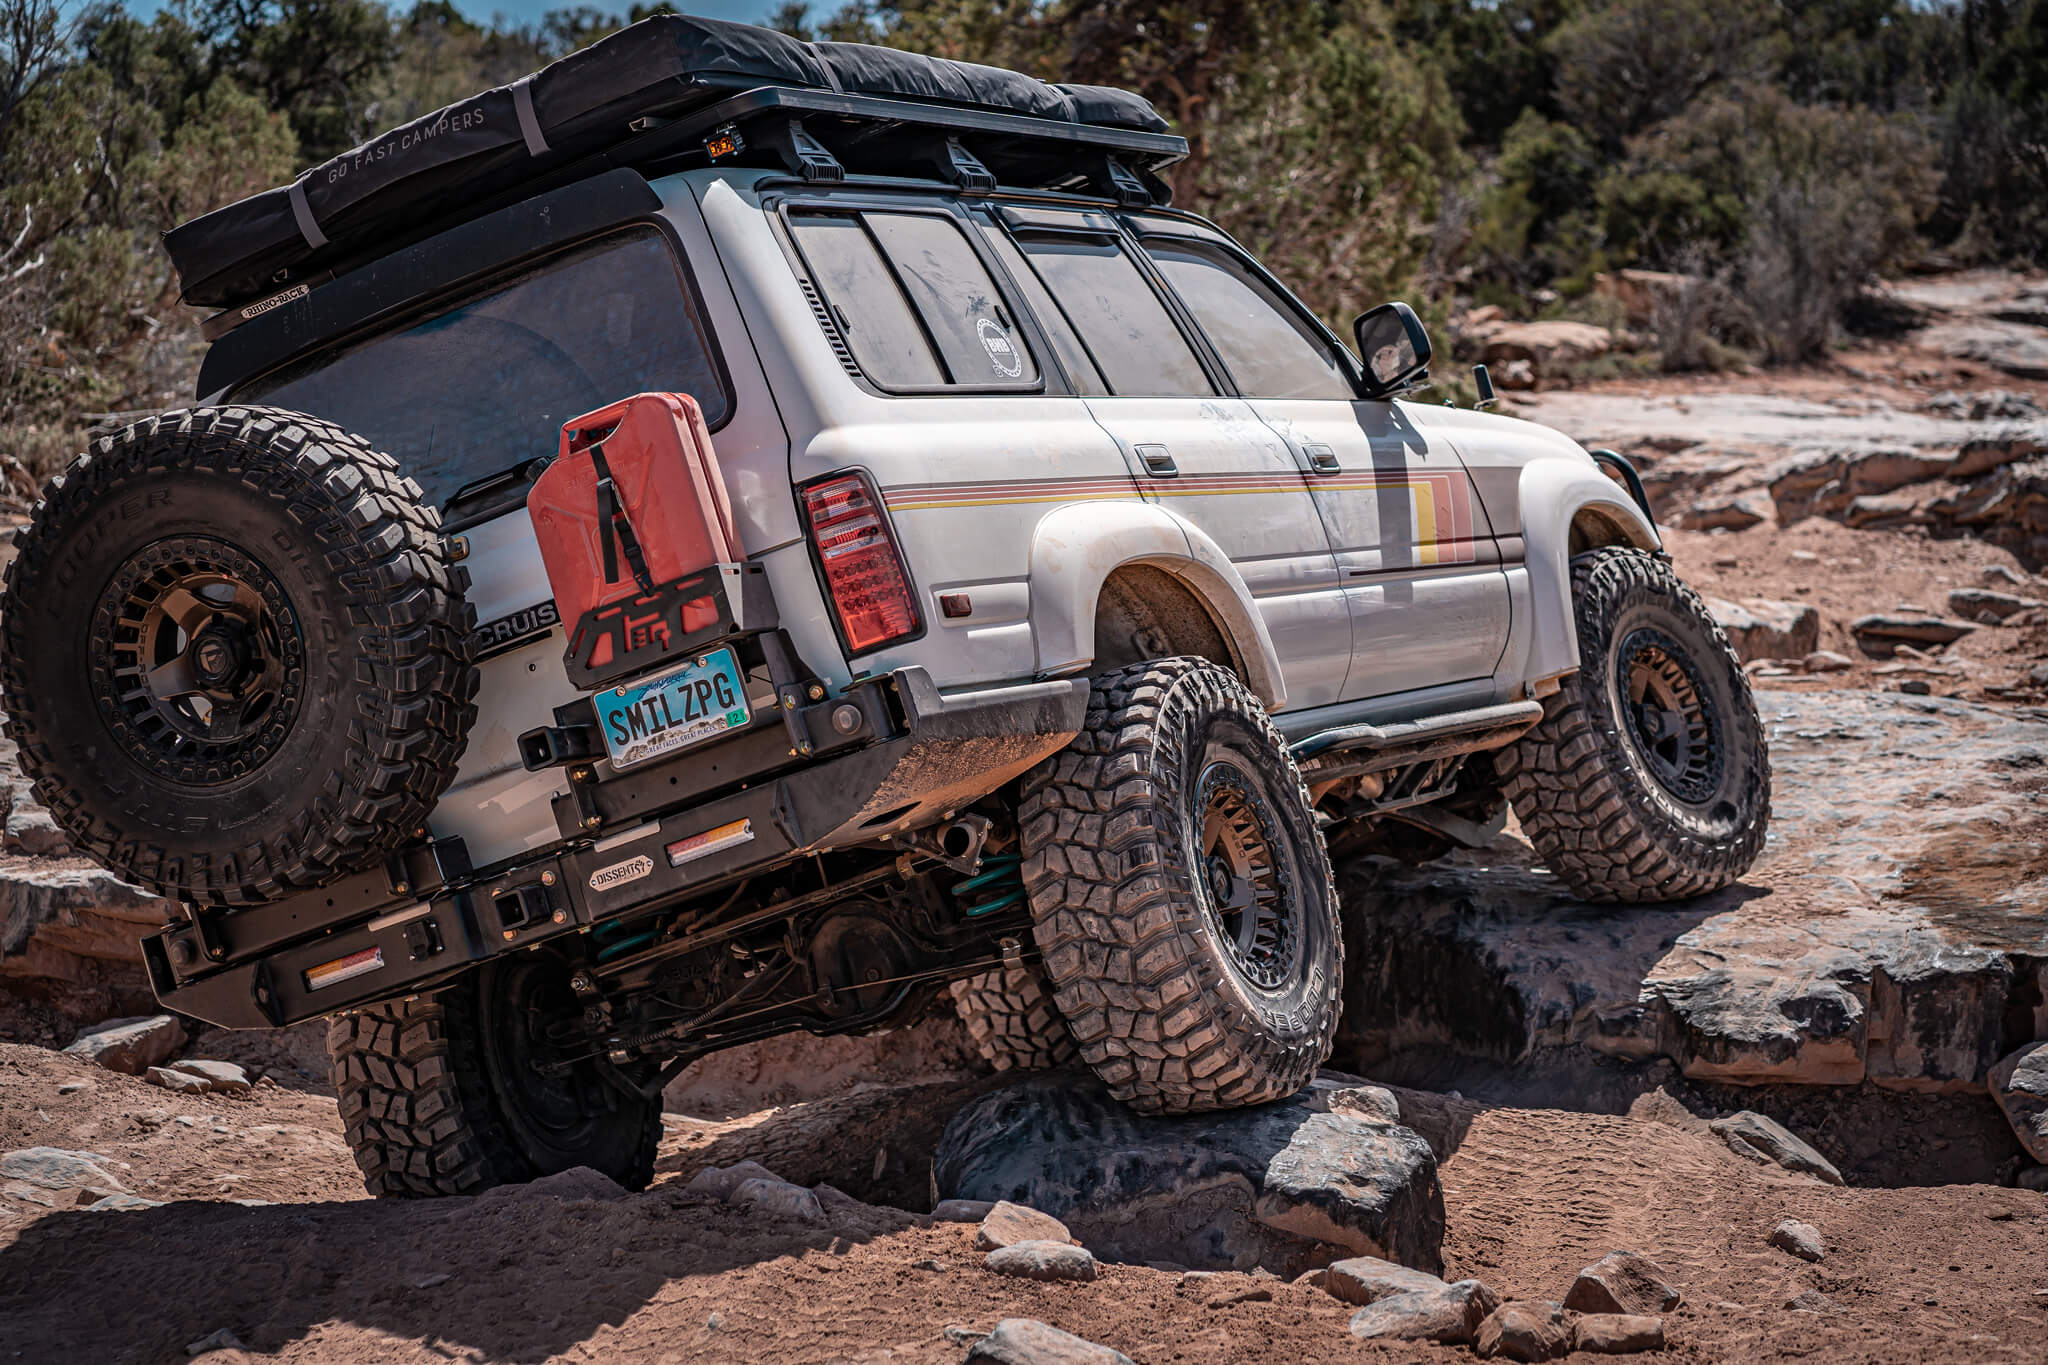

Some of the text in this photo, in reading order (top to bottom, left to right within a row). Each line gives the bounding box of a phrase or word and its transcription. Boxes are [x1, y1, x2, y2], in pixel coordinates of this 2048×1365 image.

[328, 108, 484, 184] GO FAST CAMPERS
[247, 286, 305, 316] RHINO-RACK
[608, 672, 736, 746] SMILZPG
[645, 743, 662, 754] GREAT
[680, 731, 697, 742] GREAT
[596, 862, 635, 885] DISSENT
